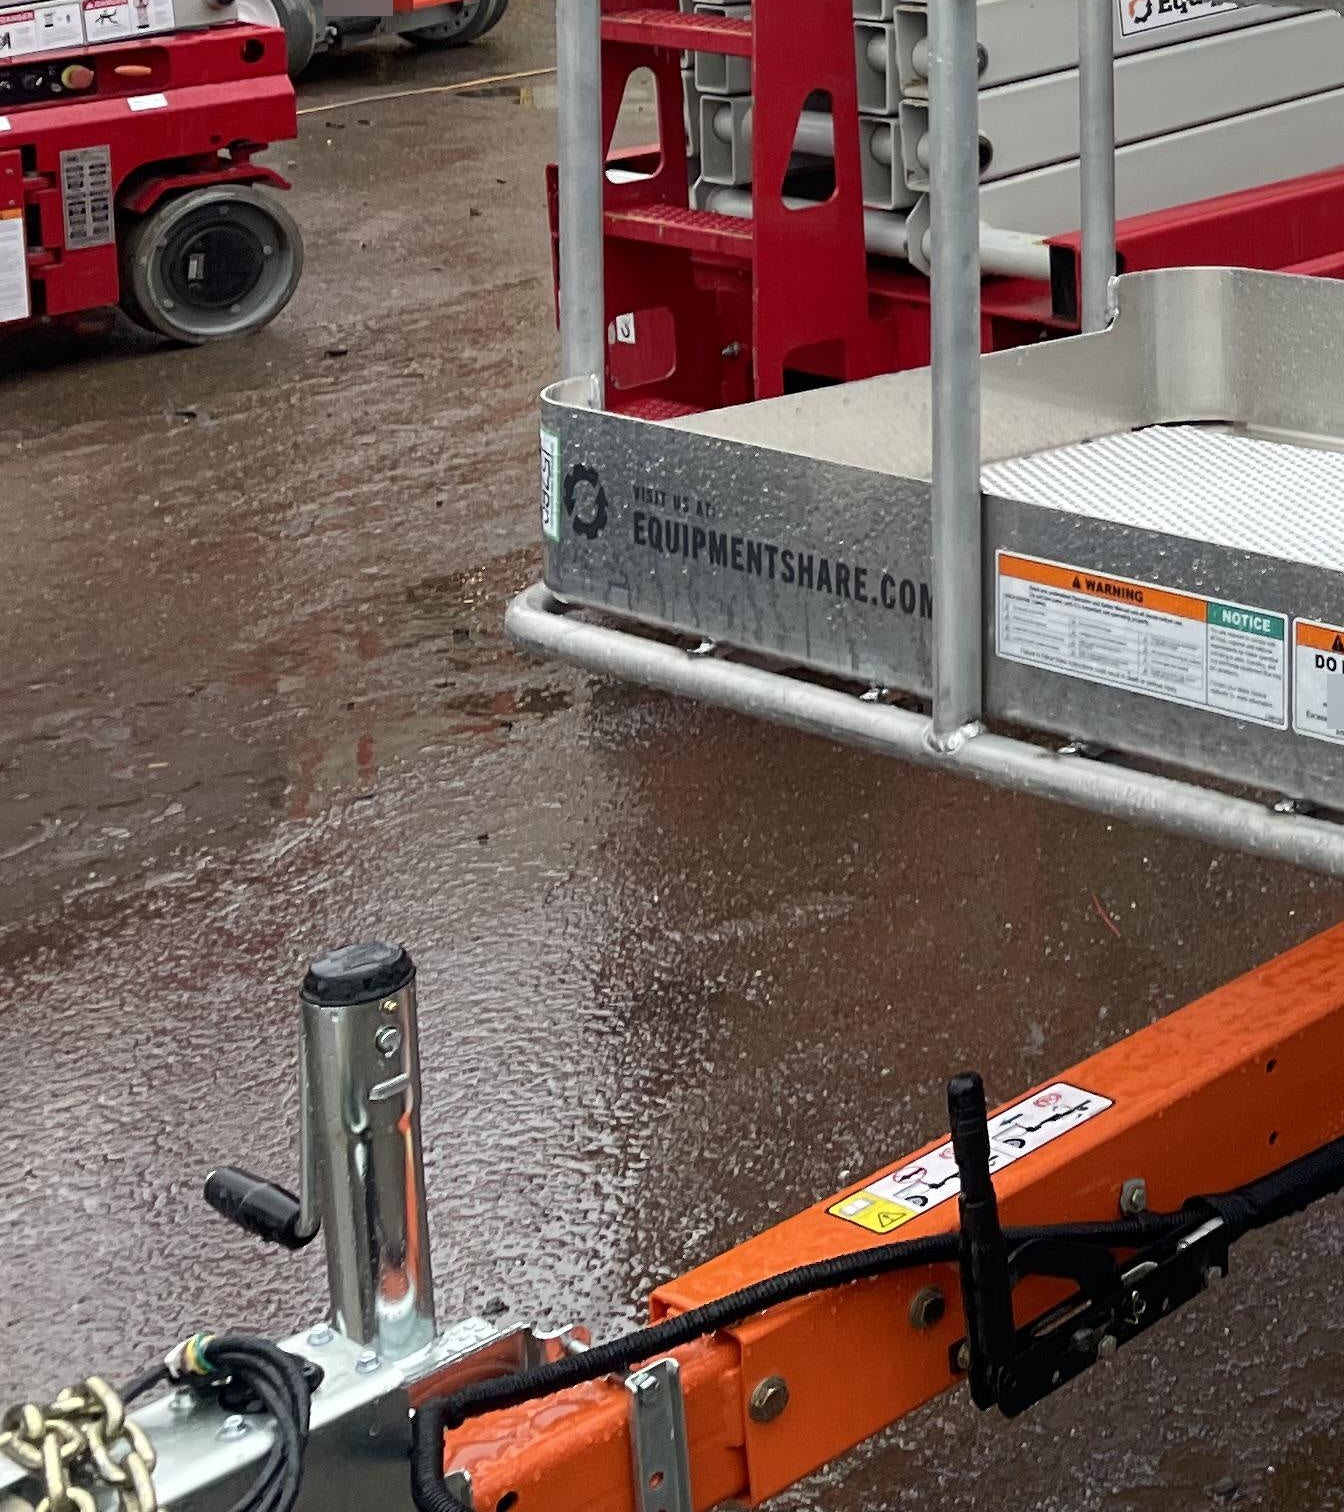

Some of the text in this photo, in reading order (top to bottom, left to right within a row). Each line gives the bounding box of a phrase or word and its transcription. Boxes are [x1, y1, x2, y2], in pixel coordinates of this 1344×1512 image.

[633, 486, 667, 510] VISIT
[671, 493, 688, 514] US
[1085, 577, 1144, 603] WARNING
[1222, 608, 1272, 633] NOTICE
[1314, 654, 1337, 672] DO
